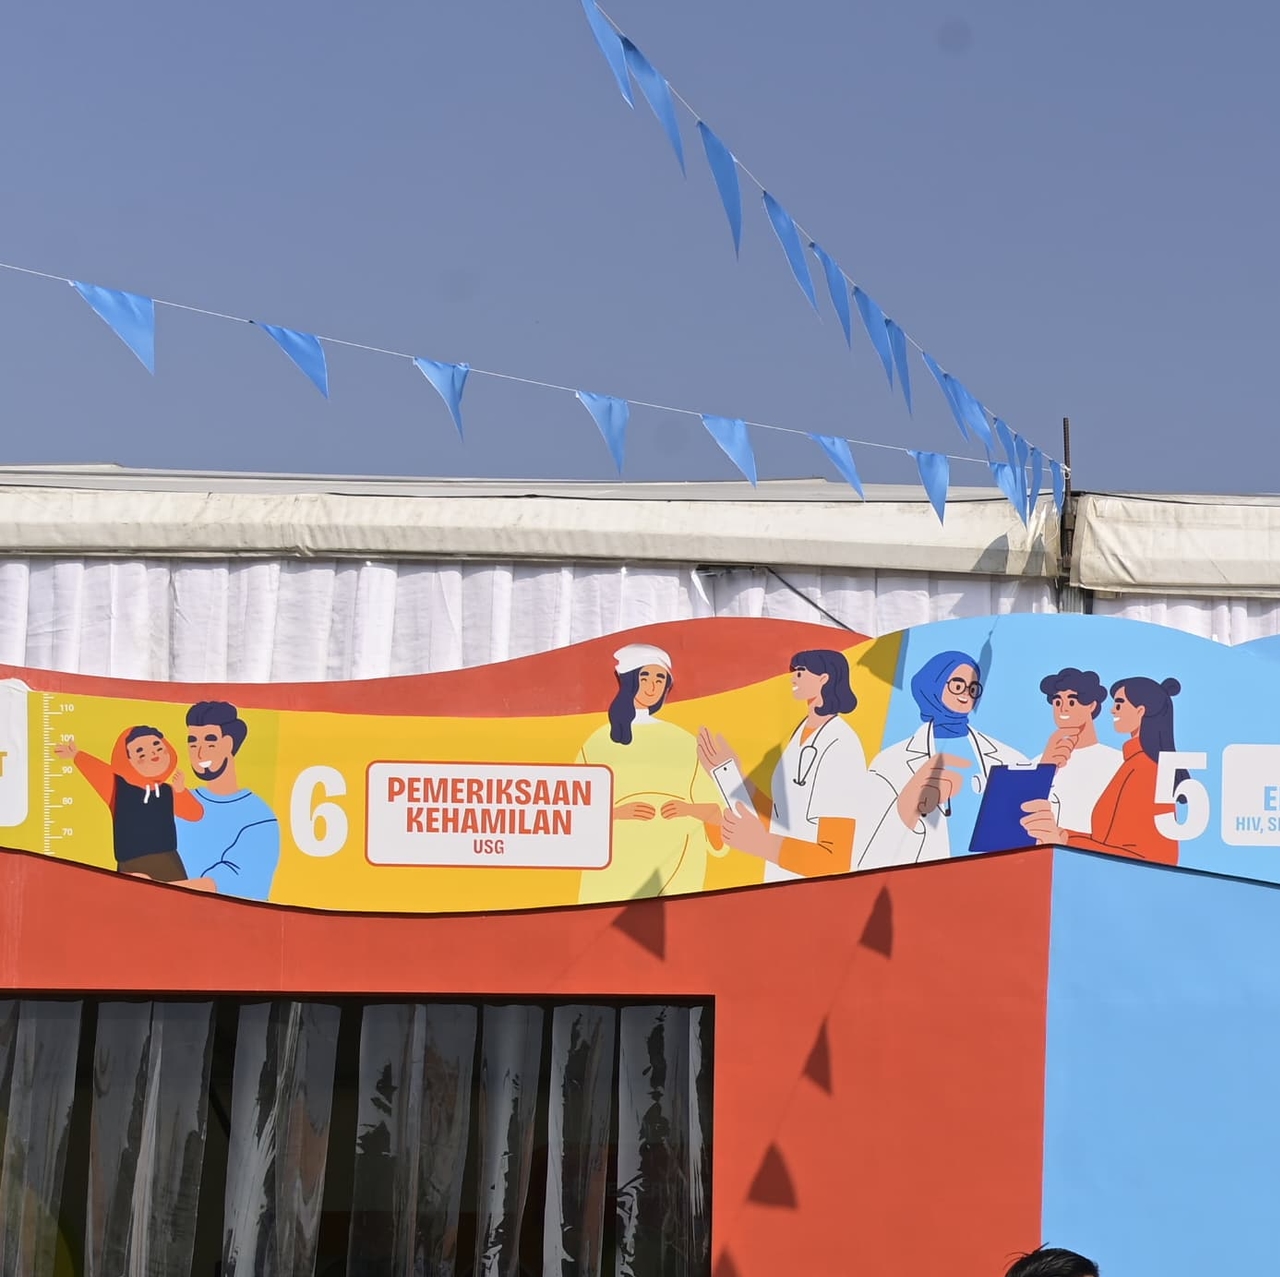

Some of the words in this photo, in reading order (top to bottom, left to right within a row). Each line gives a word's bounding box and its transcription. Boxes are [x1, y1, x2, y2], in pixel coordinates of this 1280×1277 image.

[60, 704, 75, 713] 110
[62, 766, 73, 775] 90
[387, 777, 592, 807] PEMERIKSAAN
[1154, 752, 1210, 840] 5
[290, 766, 348, 857] 6
[406, 806, 572, 836] KEHAMILAN
[62, 828, 73, 837] 70
[1235, 816, 1265, 835] HIV,
[473, 838, 504, 855] USG
